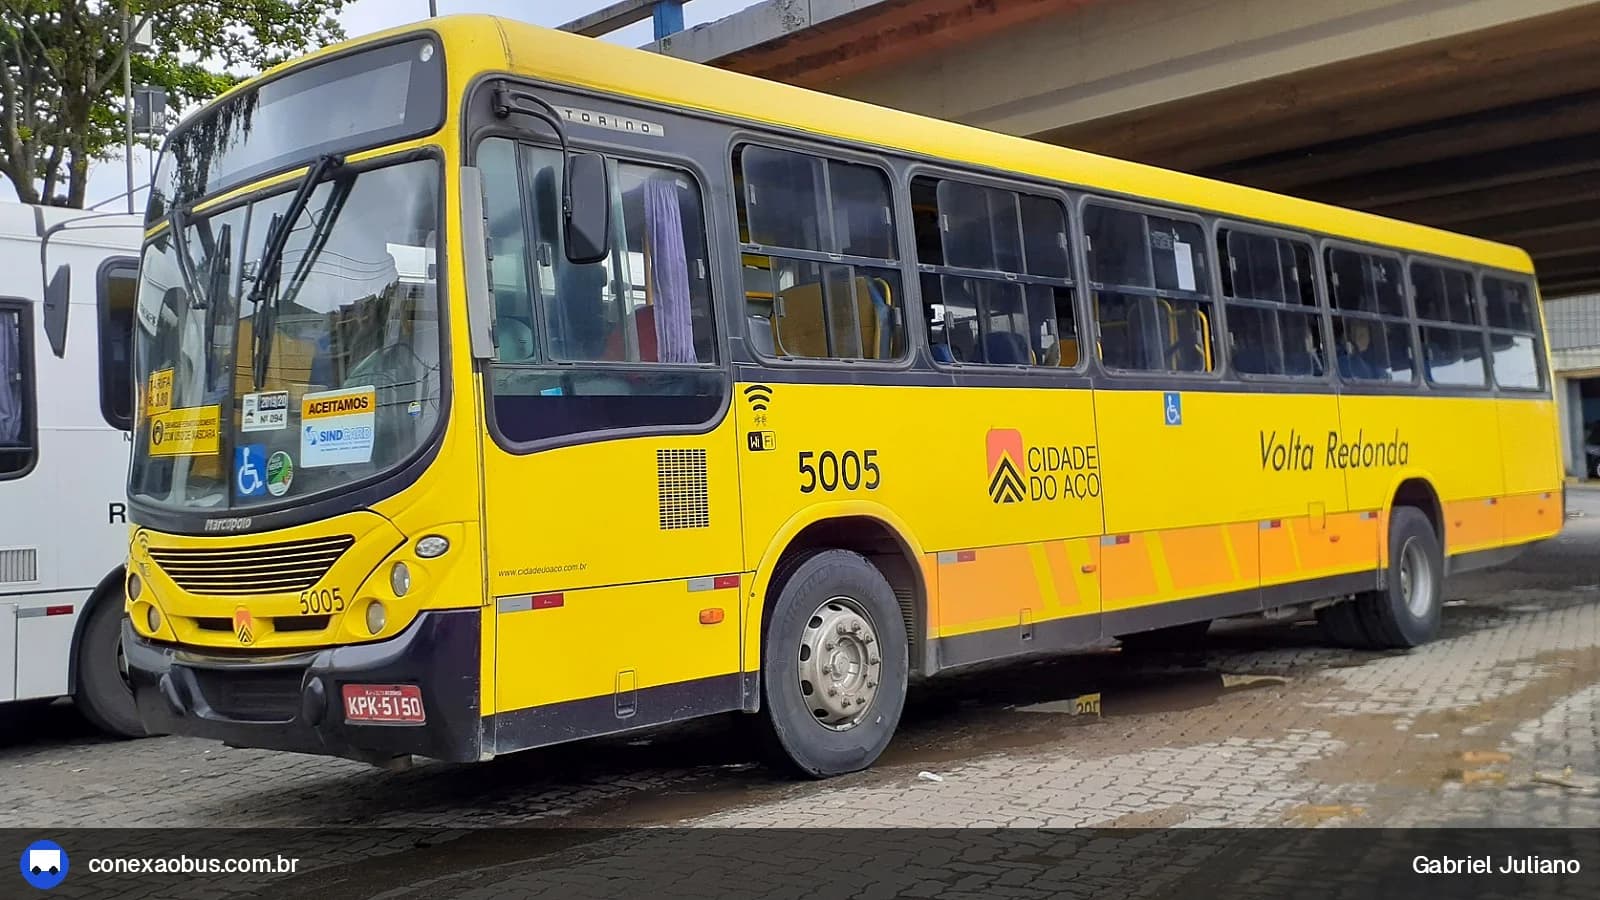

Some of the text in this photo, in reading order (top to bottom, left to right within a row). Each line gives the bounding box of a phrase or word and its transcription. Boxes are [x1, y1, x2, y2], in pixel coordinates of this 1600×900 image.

[565, 109, 650, 132] TORINO
[308, 396, 369, 416] ACEITAMOS
[269, 413, 283, 423] 094
[320, 426, 372, 442] SINDCARD
[1028, 446, 1098, 472] CIDADE
[1260, 428, 1409, 471] Volta Redonda
[799, 450, 881, 493] 5005
[1030, 472, 1100, 501] DO AÇO
[204, 517, 252, 531] Marcopolo
[300, 587, 344, 615] 5005
[348, 696, 421, 716] KPK-5150
